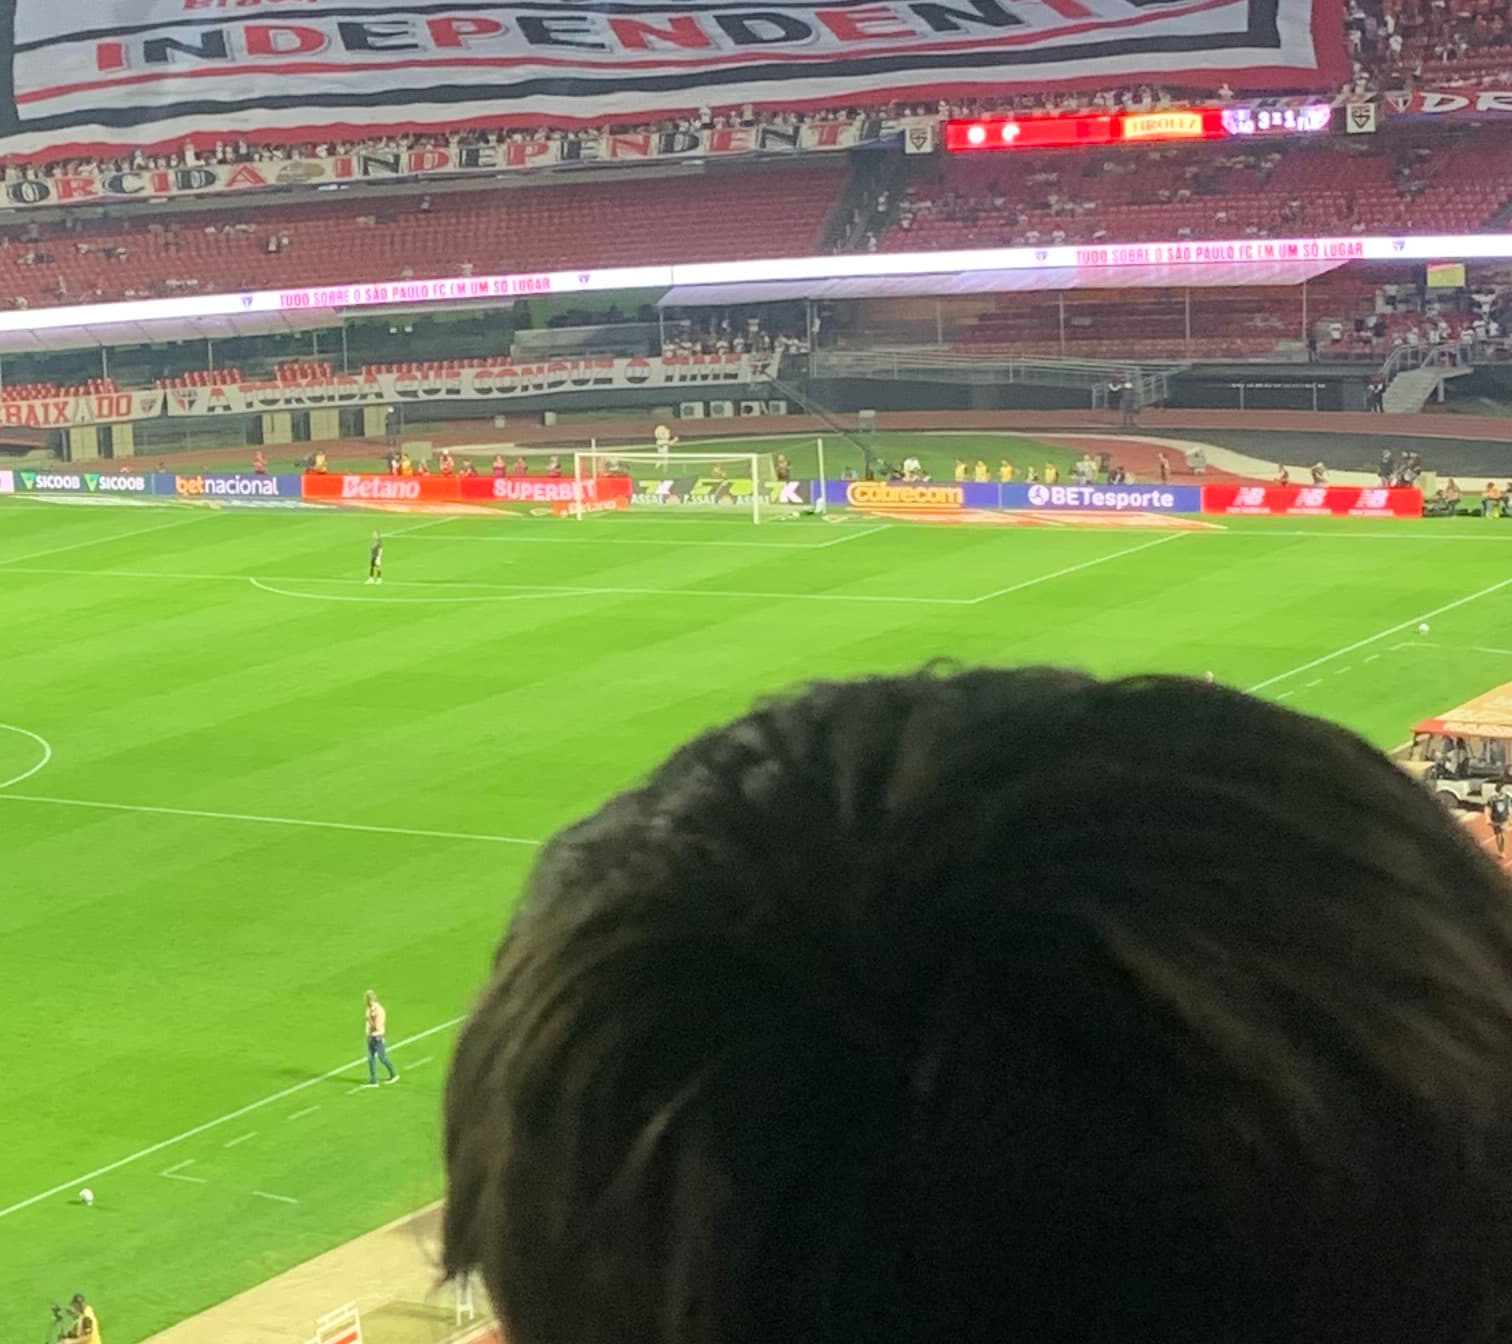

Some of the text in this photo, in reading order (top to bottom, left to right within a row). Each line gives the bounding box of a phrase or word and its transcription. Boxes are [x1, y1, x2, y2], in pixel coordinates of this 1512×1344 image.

[35, 475, 81, 490] SICOOB
[98, 475, 145, 492] SICOOB
[175, 474, 280, 496] betnacional
[342, 475, 420, 499] Betano
[1050, 485, 1174, 508] BETesporte
